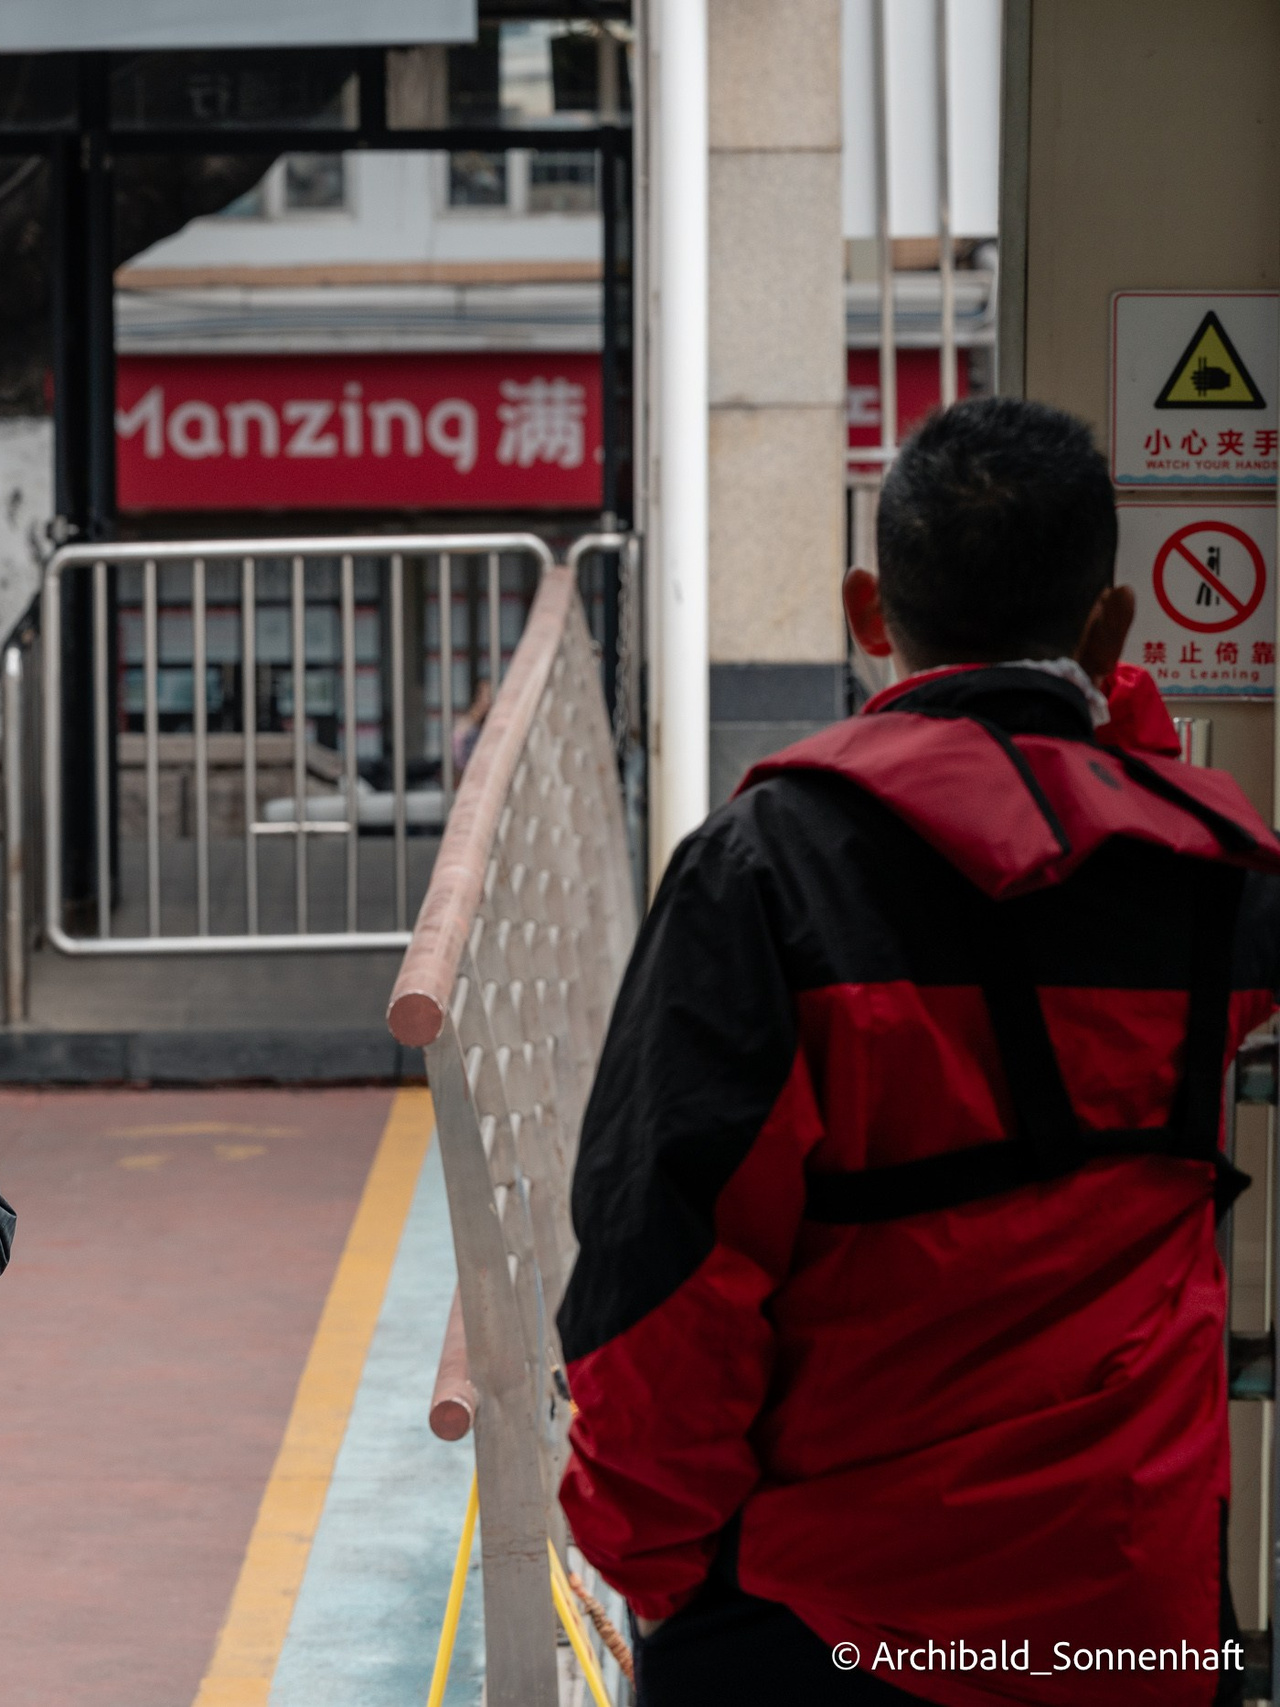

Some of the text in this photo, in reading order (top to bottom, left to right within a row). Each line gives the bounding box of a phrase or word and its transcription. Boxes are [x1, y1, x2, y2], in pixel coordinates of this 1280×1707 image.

[114, 376, 607, 475] Manzing 满
[1144, 428, 1278, 456] 小心夹手
[1146, 460, 1190, 470] WATCH
[1196, 460, 1231, 470] YOUR
[1144, 641, 1275, 665] 禁止倚靠
[1158, 668, 1259, 682] No Leaning
